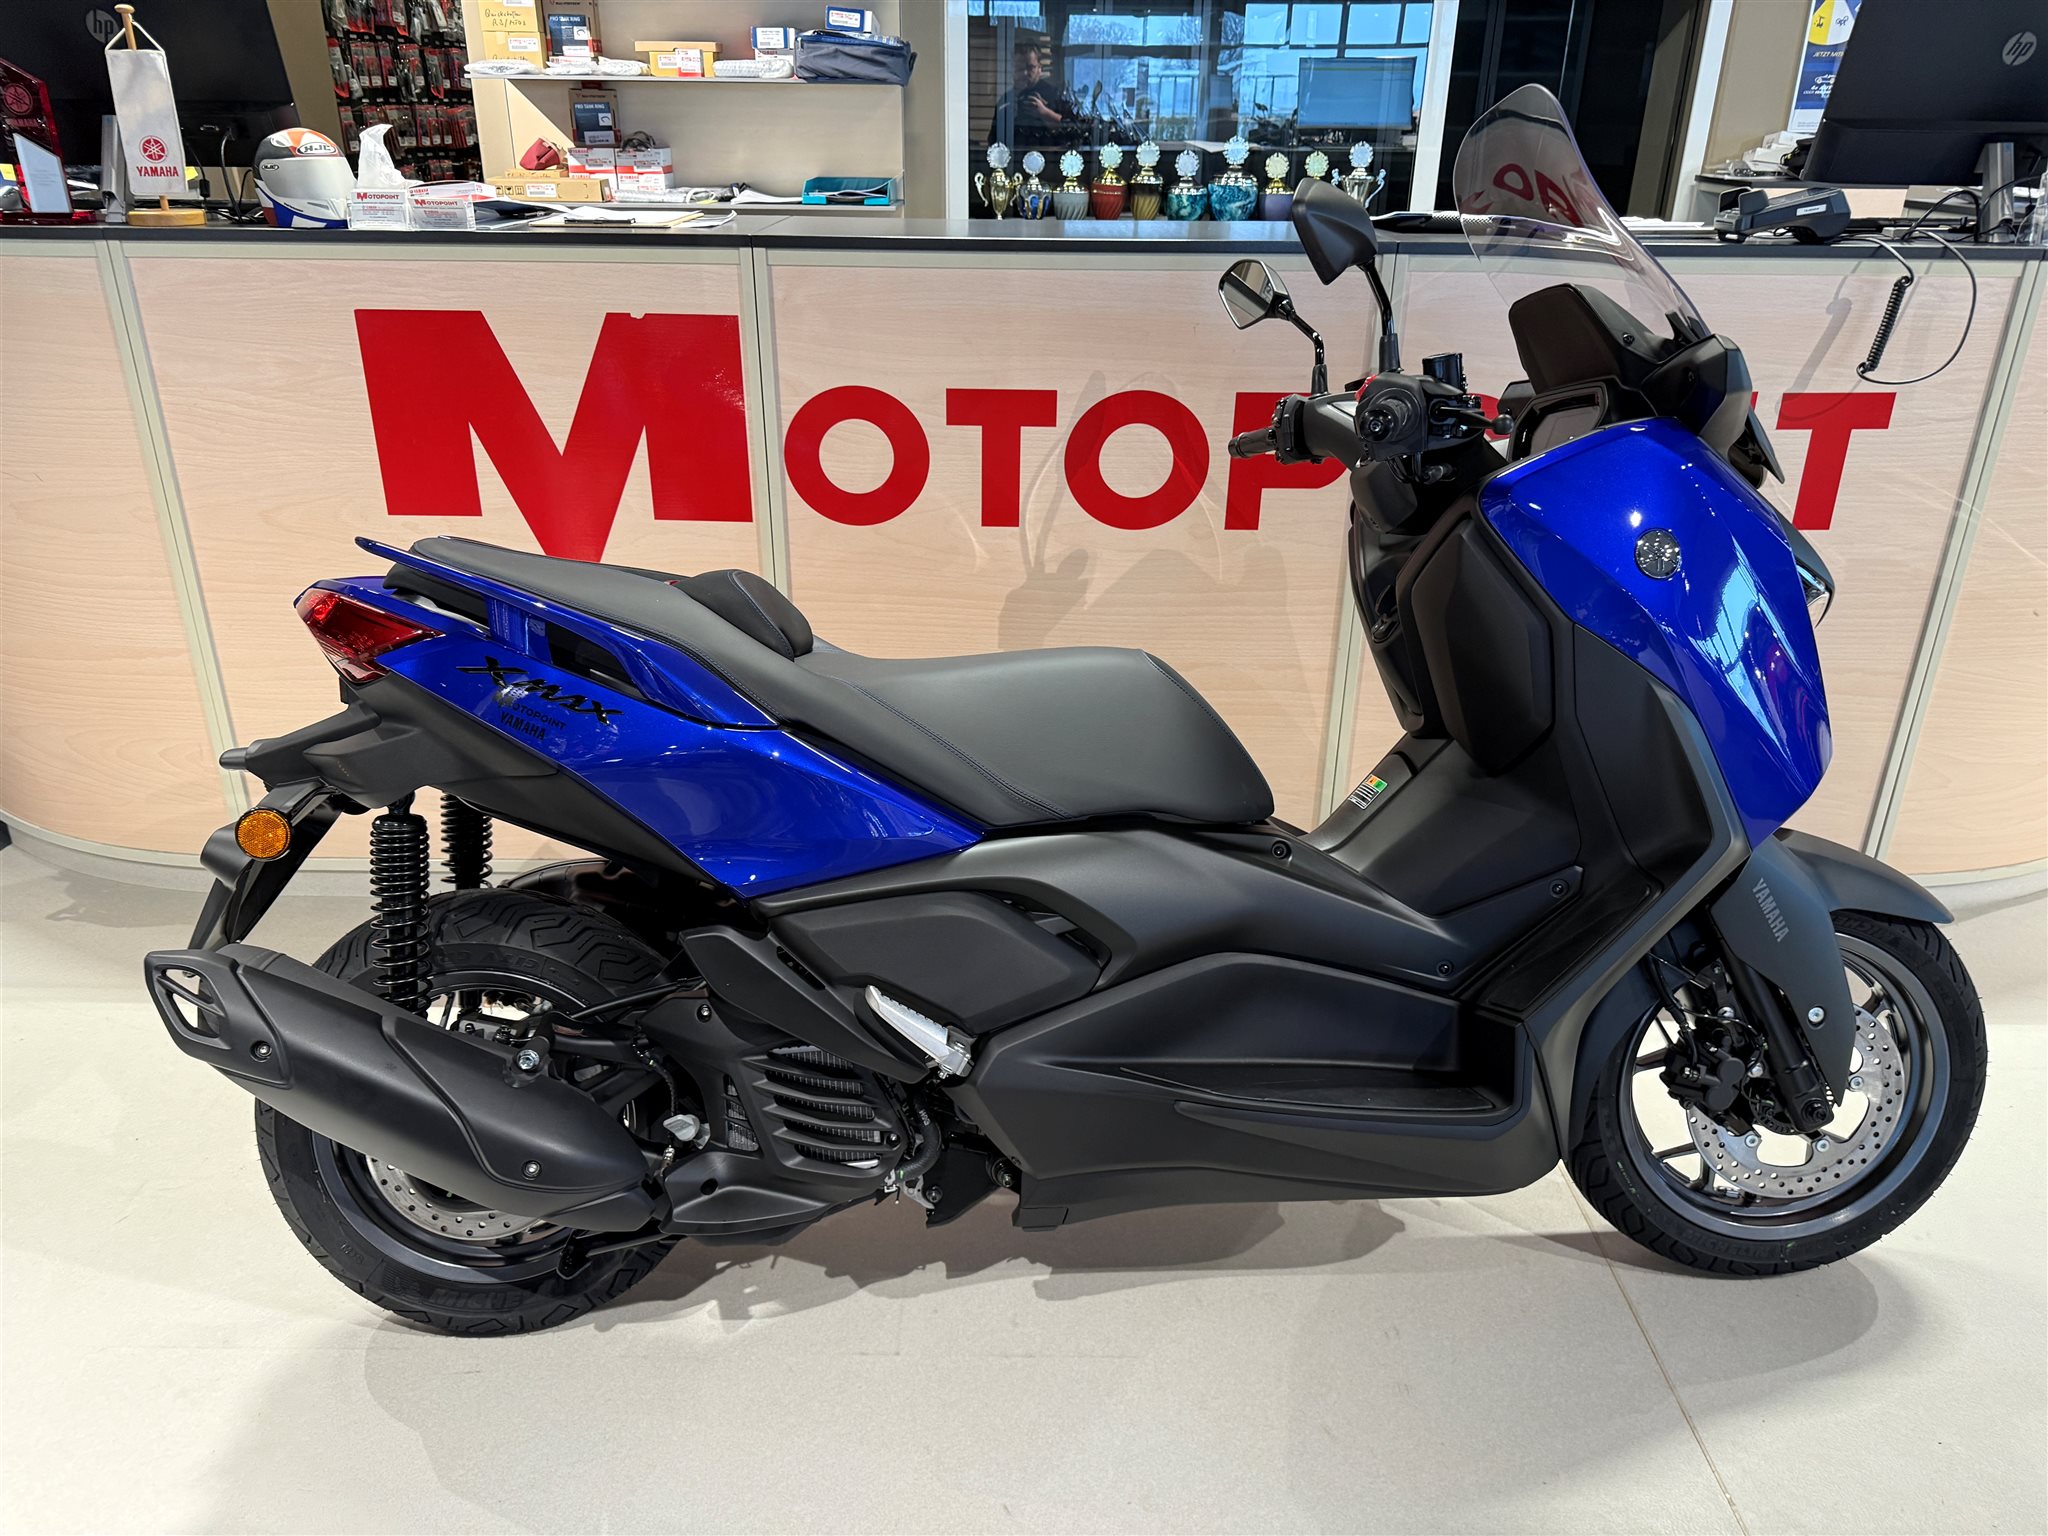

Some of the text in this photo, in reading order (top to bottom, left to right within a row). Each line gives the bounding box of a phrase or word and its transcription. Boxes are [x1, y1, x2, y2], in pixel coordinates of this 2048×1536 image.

[2004, 31, 2035, 66] hp
[303, 144, 331, 153] HJC
[136, 165, 179, 178] YAMAHA
[356, 192, 400, 201] MOTOPOINT
[354, 308, 1897, 562] MOTOPT
[500, 711, 546, 741] YAMAHA
[505, 698, 567, 731] OTOPOINT
[1752, 876, 1790, 943] YAMAHA
